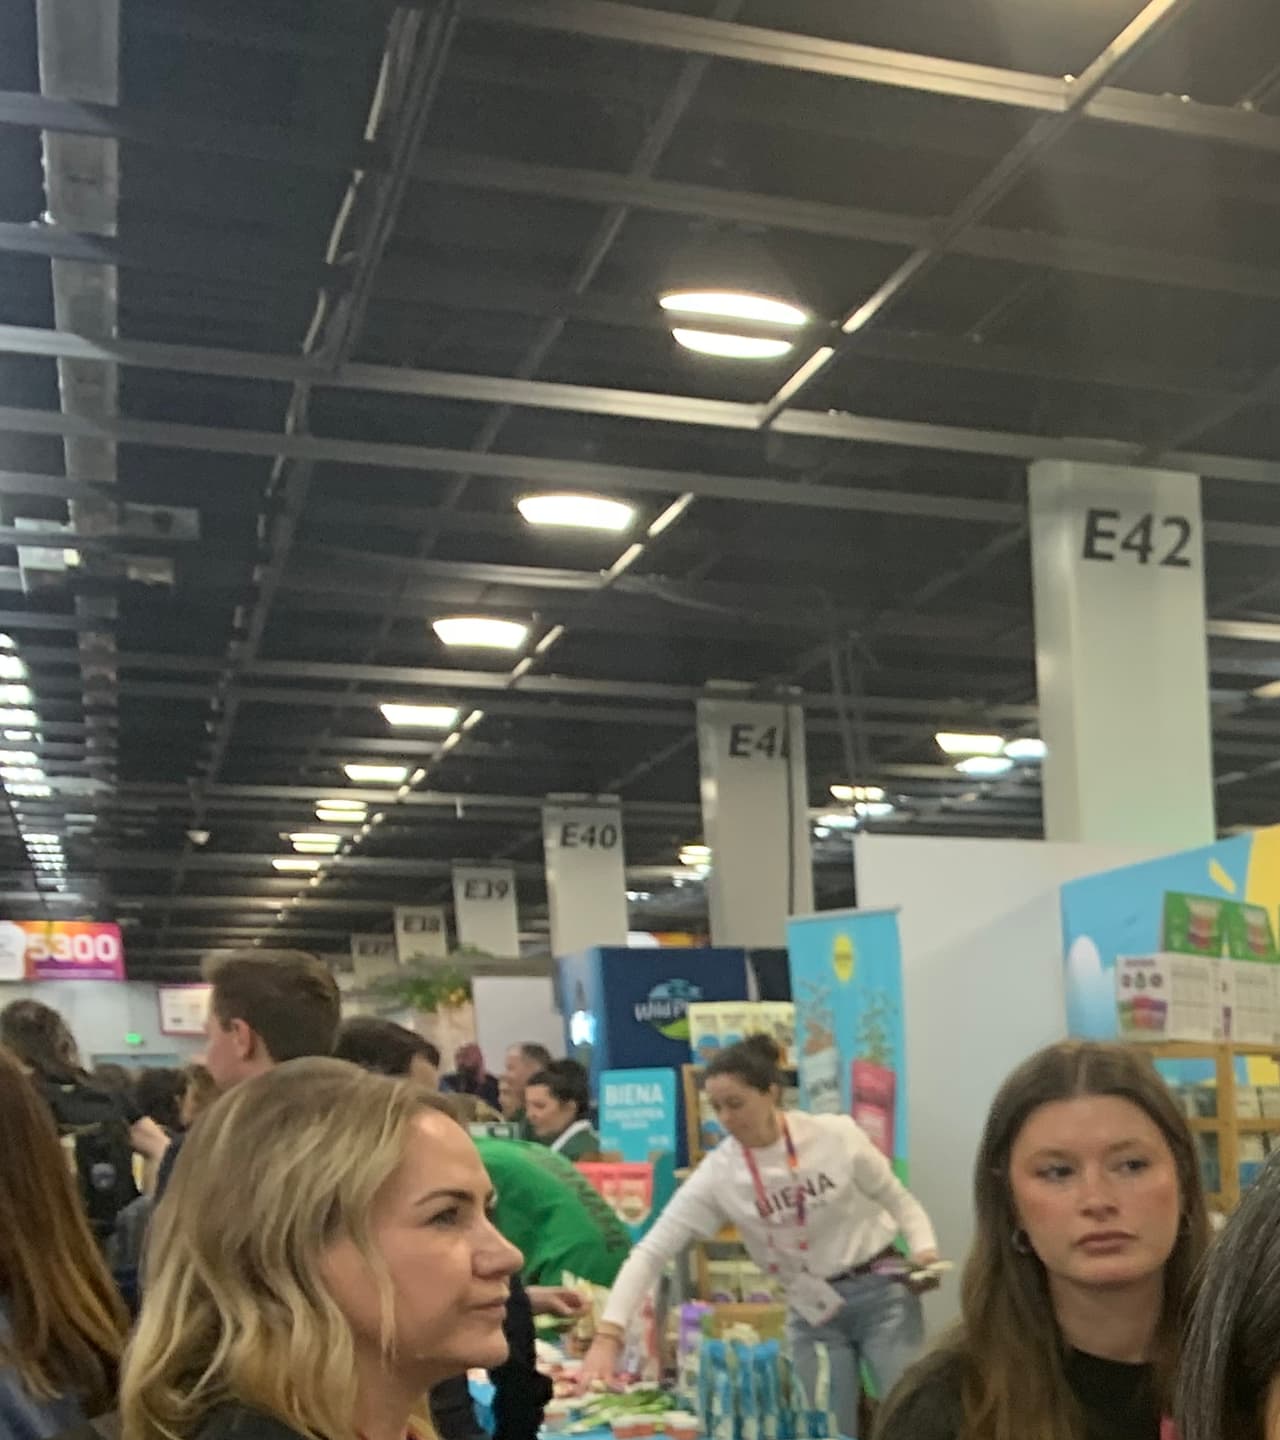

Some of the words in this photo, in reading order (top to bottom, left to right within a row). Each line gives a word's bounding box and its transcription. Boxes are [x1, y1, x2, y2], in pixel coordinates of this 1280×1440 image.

[1081, 507, 1192, 567] E42
[560, 822, 618, 849] E40
[464, 878, 509, 900] E39
[28, 934, 119, 962] 5300
